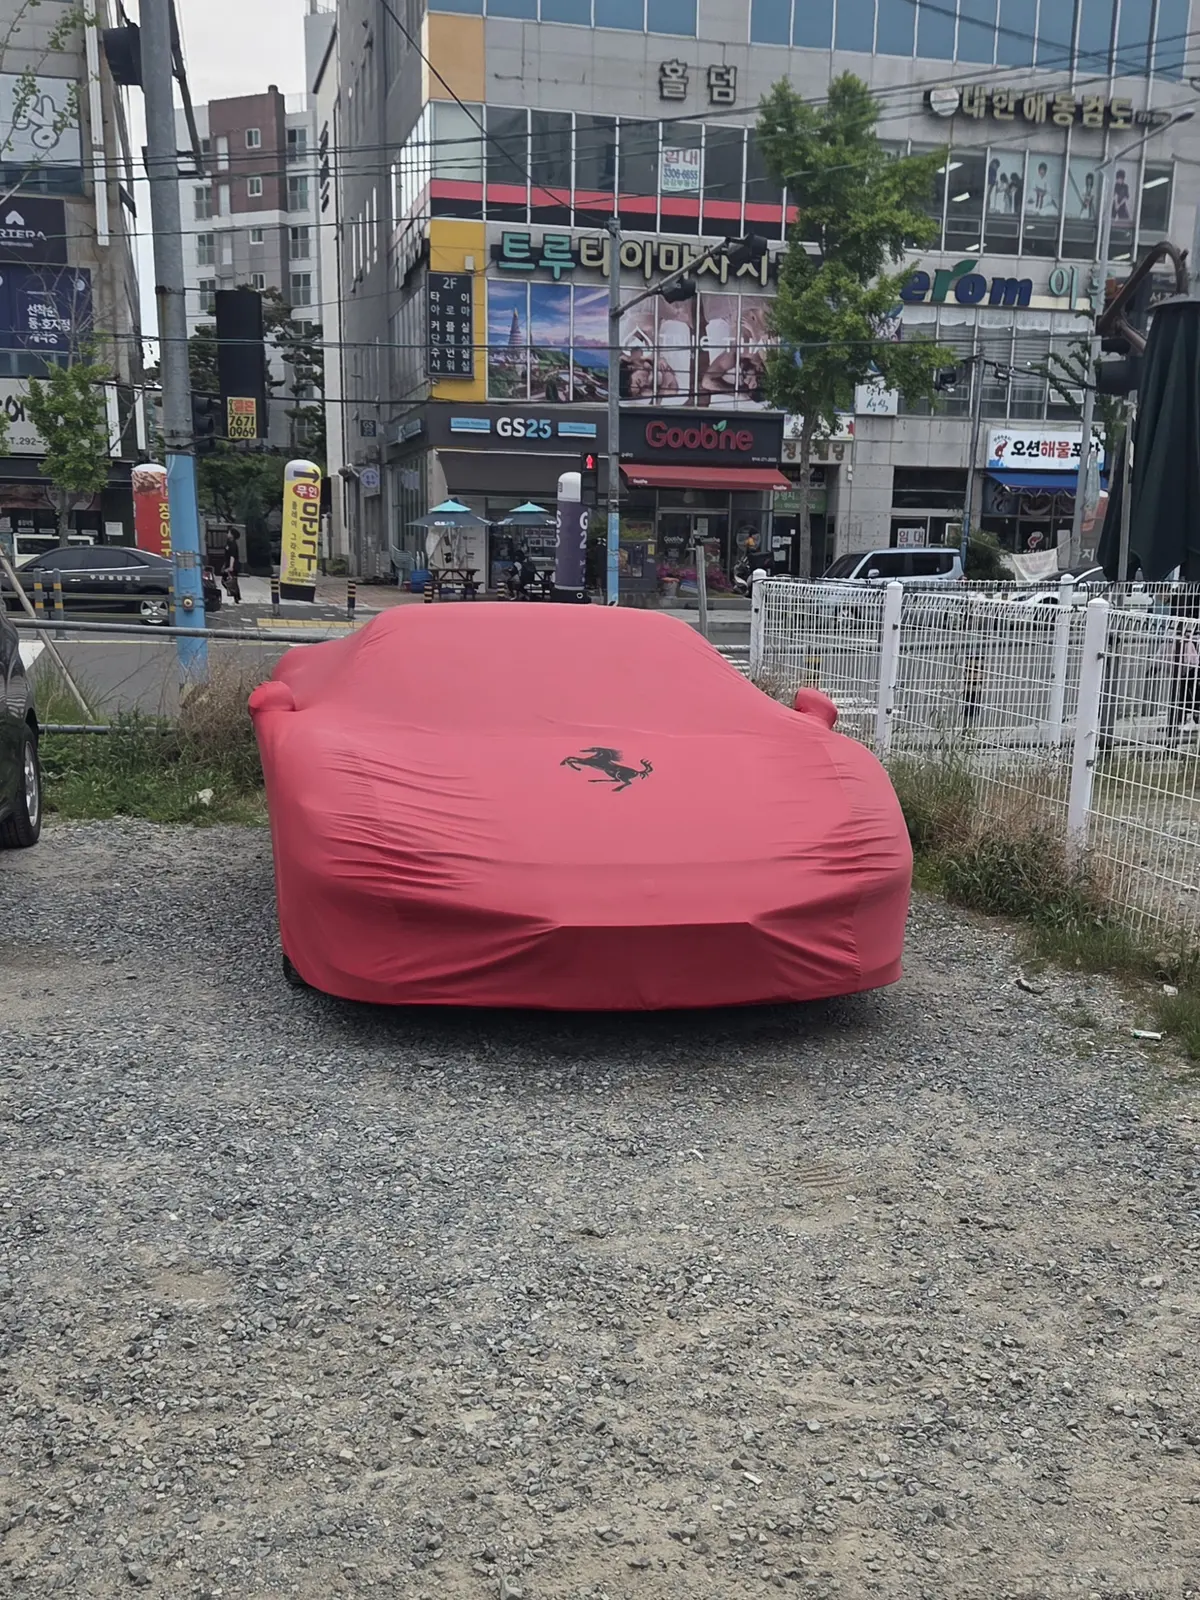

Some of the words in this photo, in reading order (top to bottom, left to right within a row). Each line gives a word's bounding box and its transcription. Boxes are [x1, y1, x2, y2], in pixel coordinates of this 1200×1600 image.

[660, 59, 737, 104] 홀덤
[664, 150, 698, 165] 임대
[443, 276, 457, 289] 2F
[430, 304, 470, 317] 아로마
[229, 415, 255, 427] 7671
[229, 426, 256, 438] 0969
[496, 417, 552, 439] GS25
[645, 420, 754, 451] Goobne
[296, 485, 318, 498] 무인
[899, 530, 925, 543] 임대
